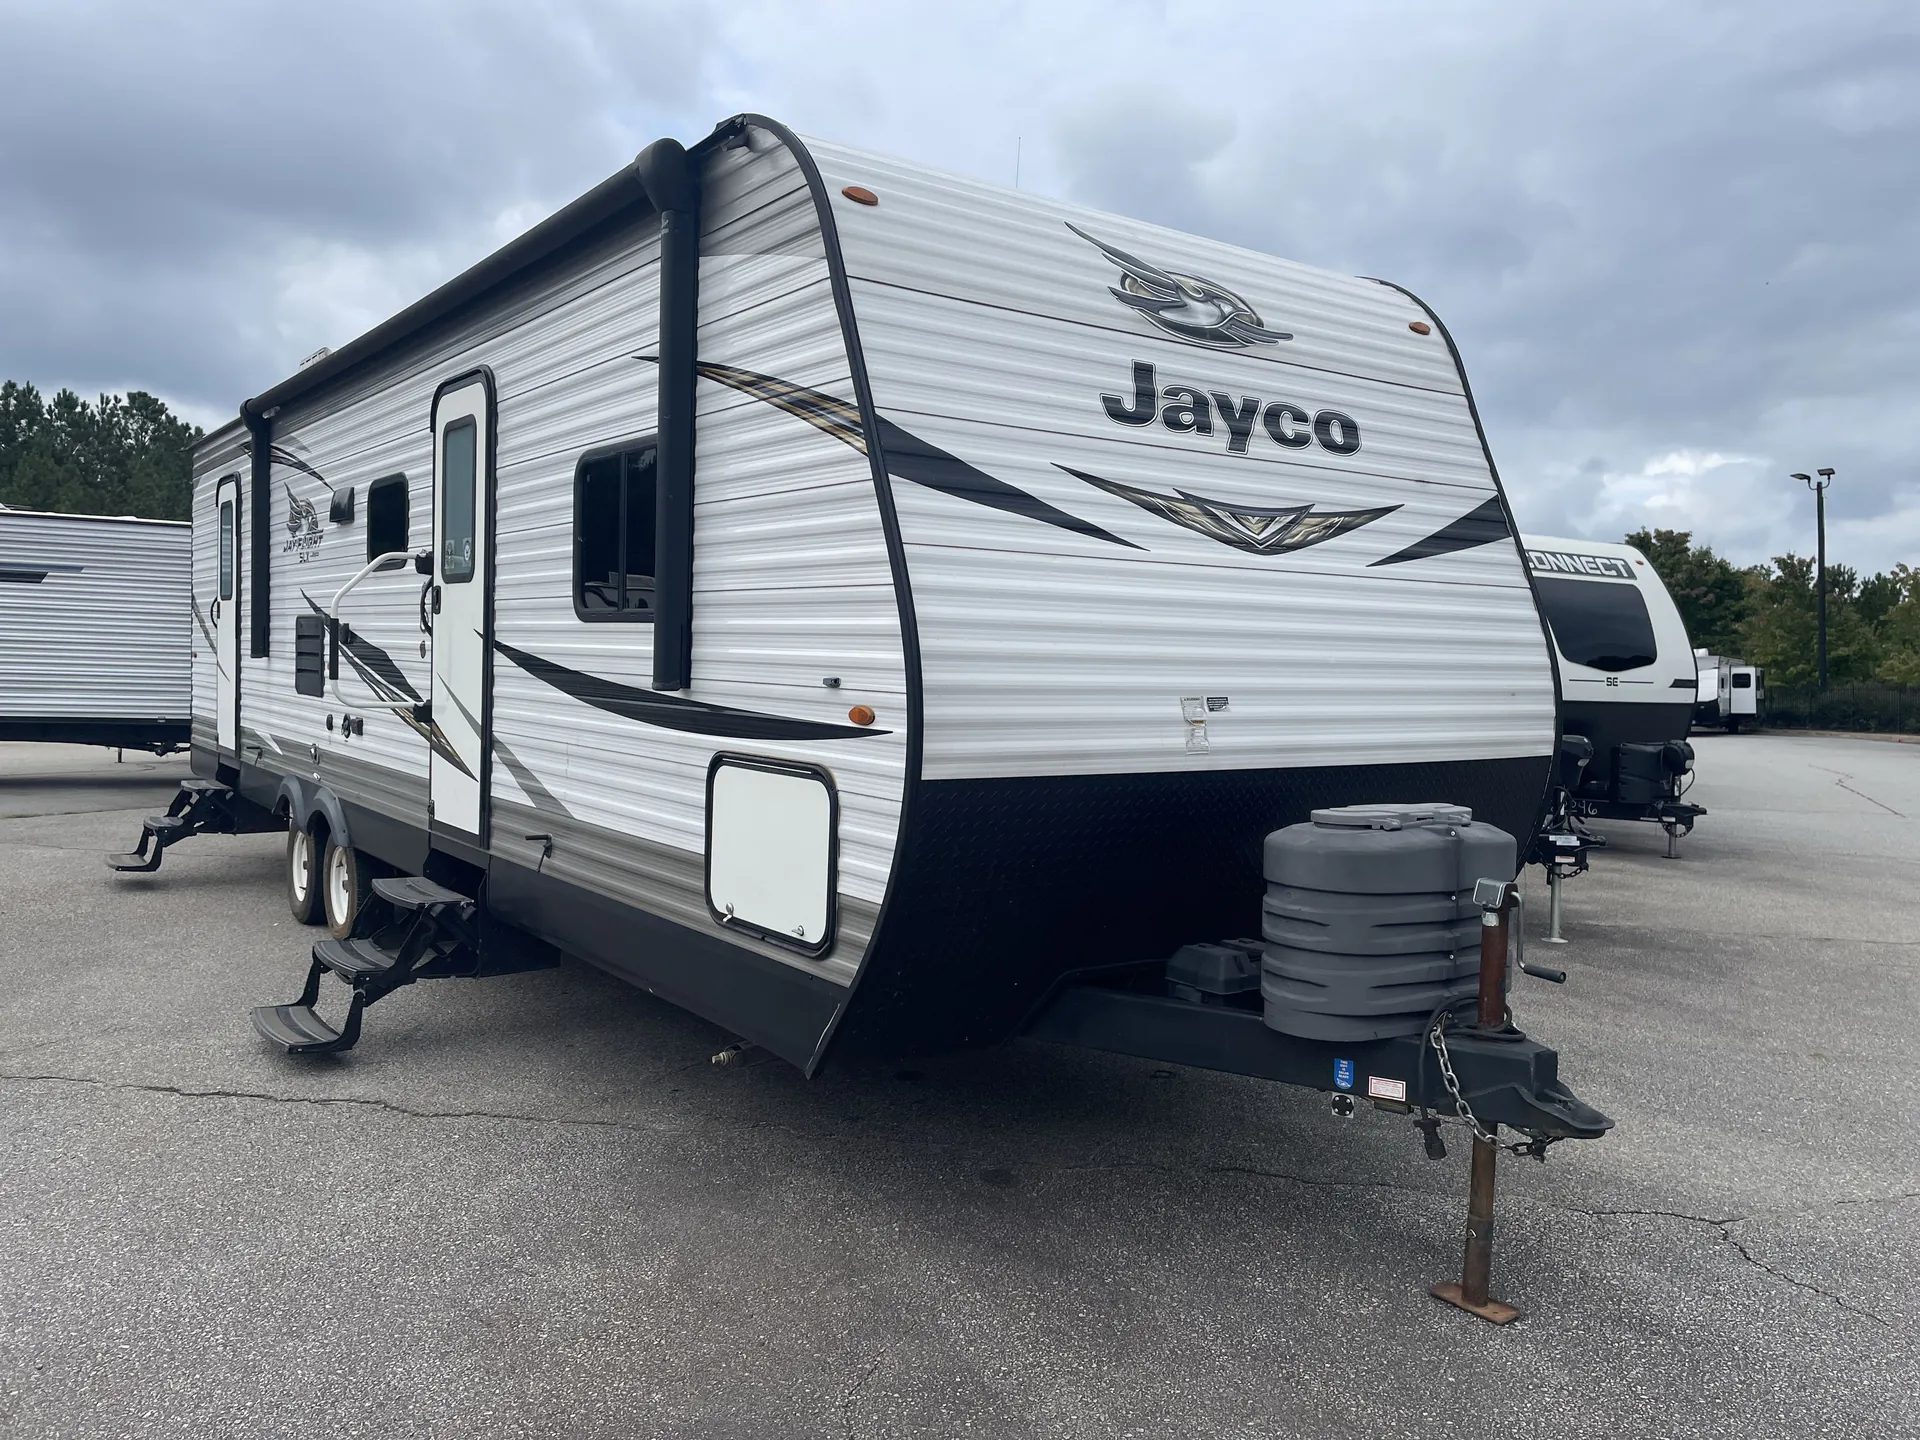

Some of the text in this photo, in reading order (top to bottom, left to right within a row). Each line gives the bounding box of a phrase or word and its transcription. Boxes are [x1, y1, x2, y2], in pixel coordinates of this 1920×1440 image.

[1100, 359, 1362, 456] Jayco
[1526, 551, 1629, 577] ONNECT
[1606, 676, 1619, 687] SE
